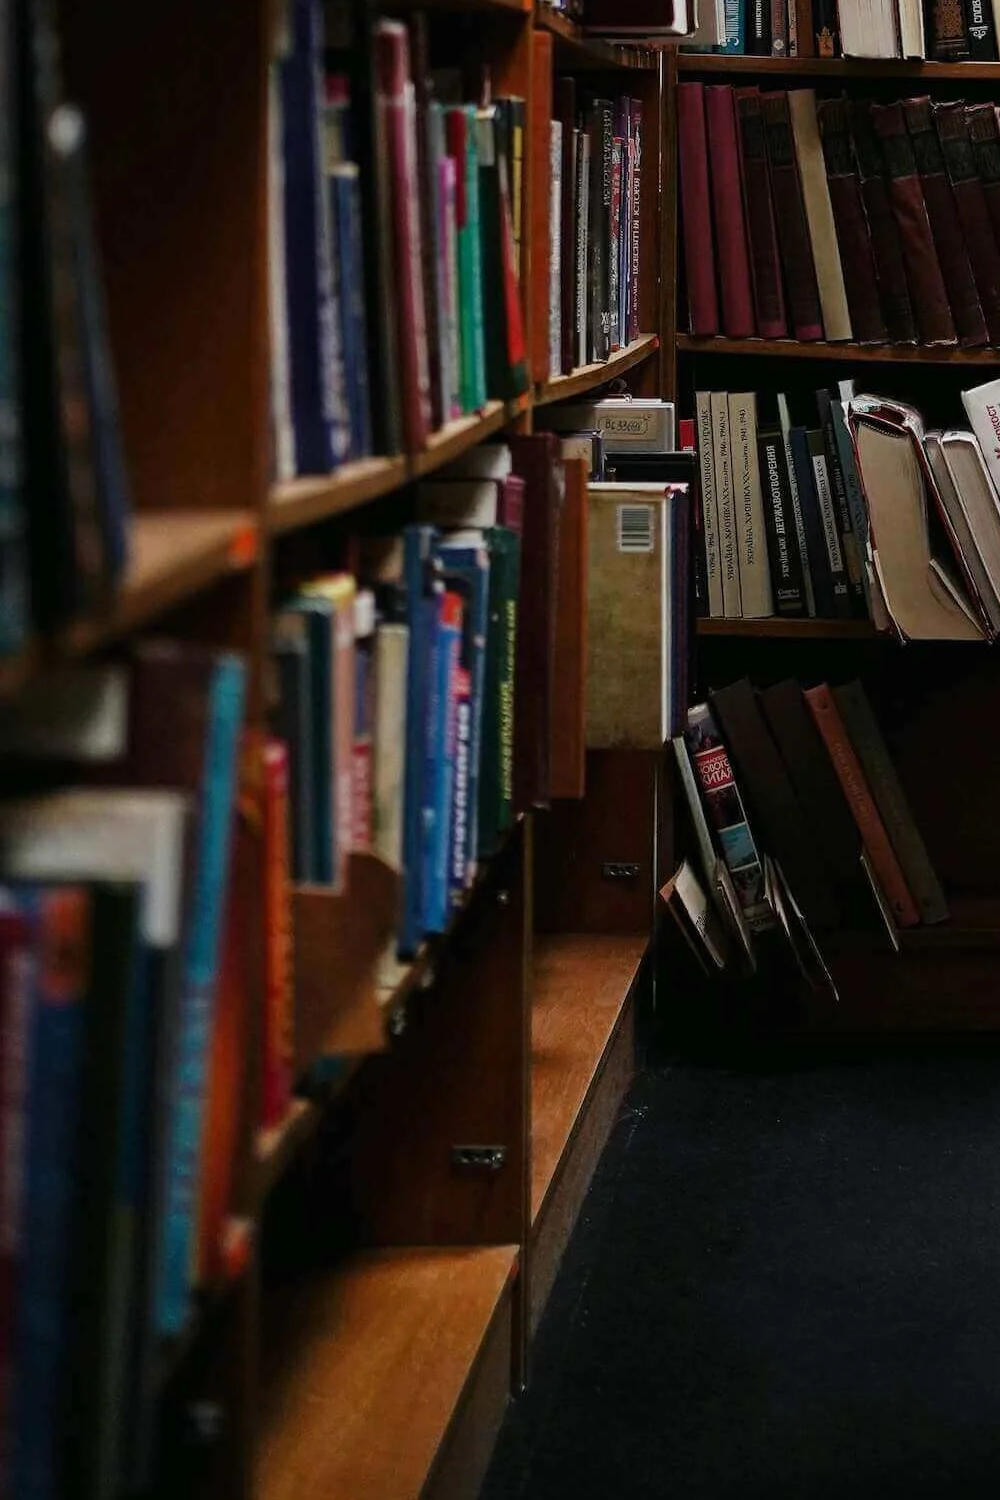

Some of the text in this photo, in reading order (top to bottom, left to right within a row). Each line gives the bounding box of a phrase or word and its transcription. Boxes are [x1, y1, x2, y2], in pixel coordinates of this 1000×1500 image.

[743, 485, 753, 524] ХРОНІКА
[766, 445, 785, 535] ДЕРЖАВОТВОРЕННЯ
[722, 500, 733, 540] ХРОНІКА
